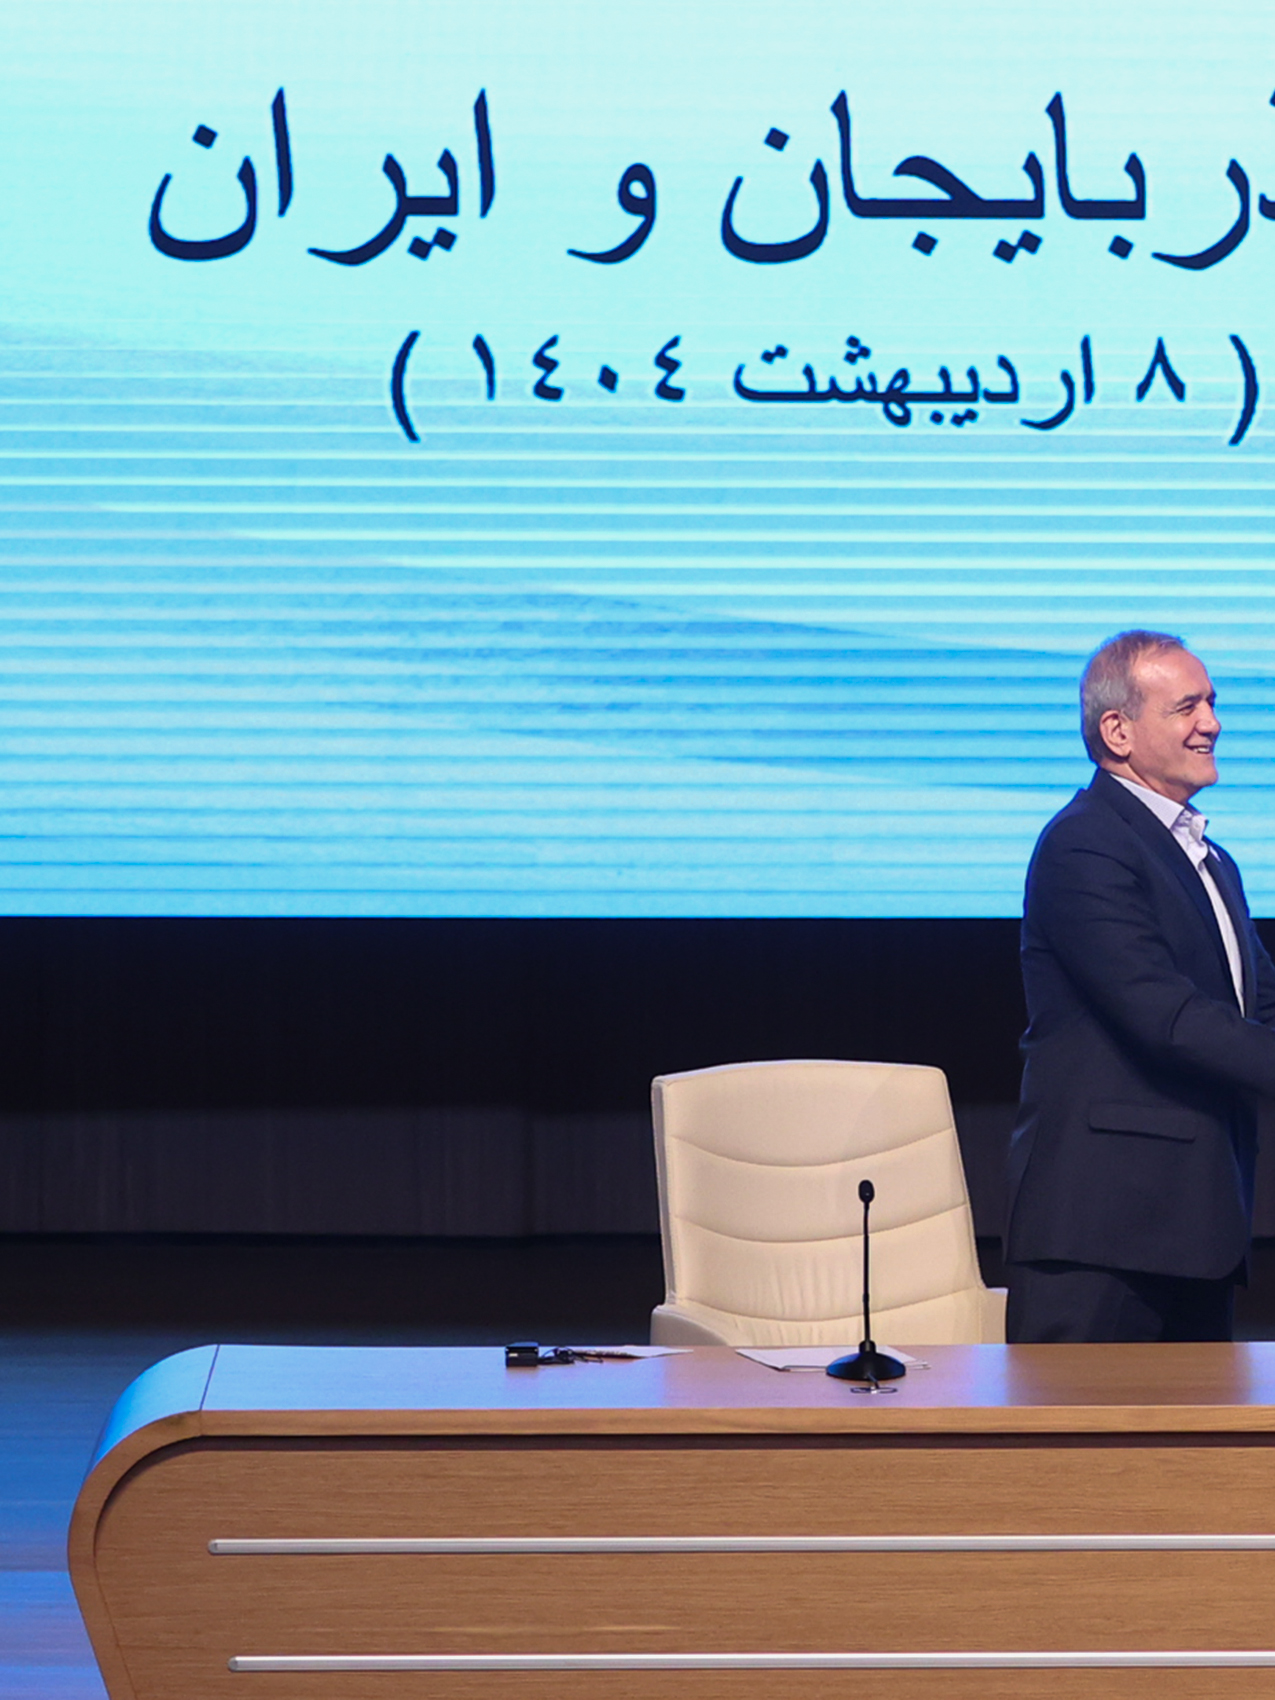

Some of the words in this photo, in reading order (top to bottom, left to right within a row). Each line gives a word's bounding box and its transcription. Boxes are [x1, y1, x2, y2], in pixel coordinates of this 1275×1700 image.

[149, 88, 495, 265] ایران
[567, 162, 657, 264] و
[734, 335, 1101, 430] اردیبهشت
